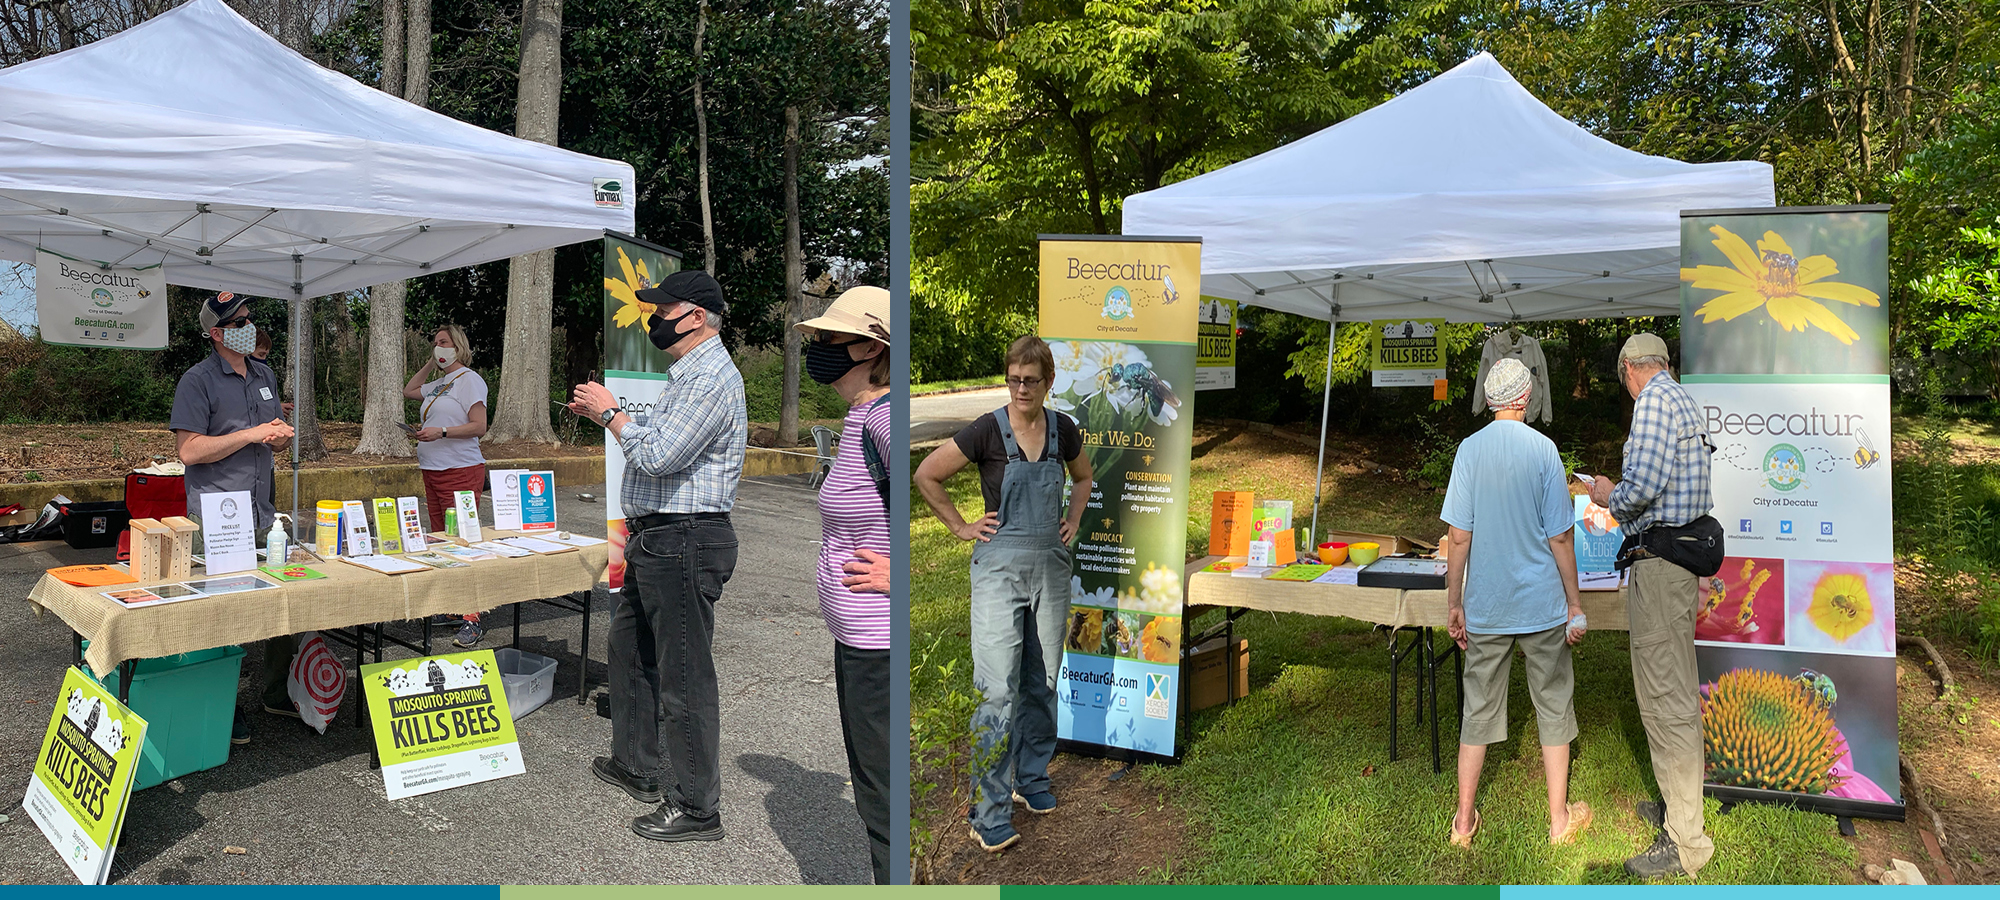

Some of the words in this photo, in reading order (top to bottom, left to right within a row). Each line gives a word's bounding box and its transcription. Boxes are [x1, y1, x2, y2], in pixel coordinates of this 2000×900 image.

[594, 190, 620, 202] Eurmax
[1067, 258, 1170, 280] Beecatur
[60, 262, 140, 288] Beecatur
[74, 316, 134, 330] BeecaturGA.com
[1214, 325, 1230, 335] SPRAYING
[1198, 338, 1213, 358] ILLS
[1214, 338, 1231, 358] BEES
[1384, 339, 1410, 347] MOSQUITO
[1380, 349, 1409, 363] KILLS
[1412, 348, 1438, 363] BEES
[1703, 406, 1863, 436] Beecatur
[1108, 430, 1130, 446] We
[1134, 432, 1155, 448] Do:
[1125, 471, 1172, 482] CONSERVATION
[1148, 484, 1170, 492] maintain
[1091, 491, 1103, 500] ough
[1121, 493, 1144, 502] pollinator
[1145, 494, 1165, 503] habitats
[1753, 497, 1772, 507] City
[1772, 498, 1781, 506] of
[1782, 498, 1818, 507] Decatur
[1131, 504, 1139, 513] city
[1140, 505, 1161, 514] property
[1090, 532, 1124, 543] ADVOCACY
[1078, 542, 1098, 551] Promote
[1099, 544, 1125, 553] pollinators
[1583, 542, 1614, 557] PLEDGE
[1076, 554, 1102, 562] sustainable
[1103, 556, 1124, 564] practices
[1093, 563, 1112, 572] decision
[1062, 666, 1138, 689] BeecaturGA.com
[394, 694, 443, 714] MOSQUITO
[444, 687, 487, 706] SPRAYING
[1146, 700, 1168, 708] XERCES
[1146, 706, 1168, 715] SOCIETY
[390, 712, 450, 749] KILLS
[452, 705, 500, 738] BEES
[60, 719, 87, 752] MOSQUITO
[84, 740, 112, 778] SPRAYING
[479, 751, 504, 761] Beecatur
[45, 736, 79, 790] KILLS
[73, 764, 109, 822] BEES
[403, 770, 471, 788] BeecaturGA.com/mosquito-spraying
